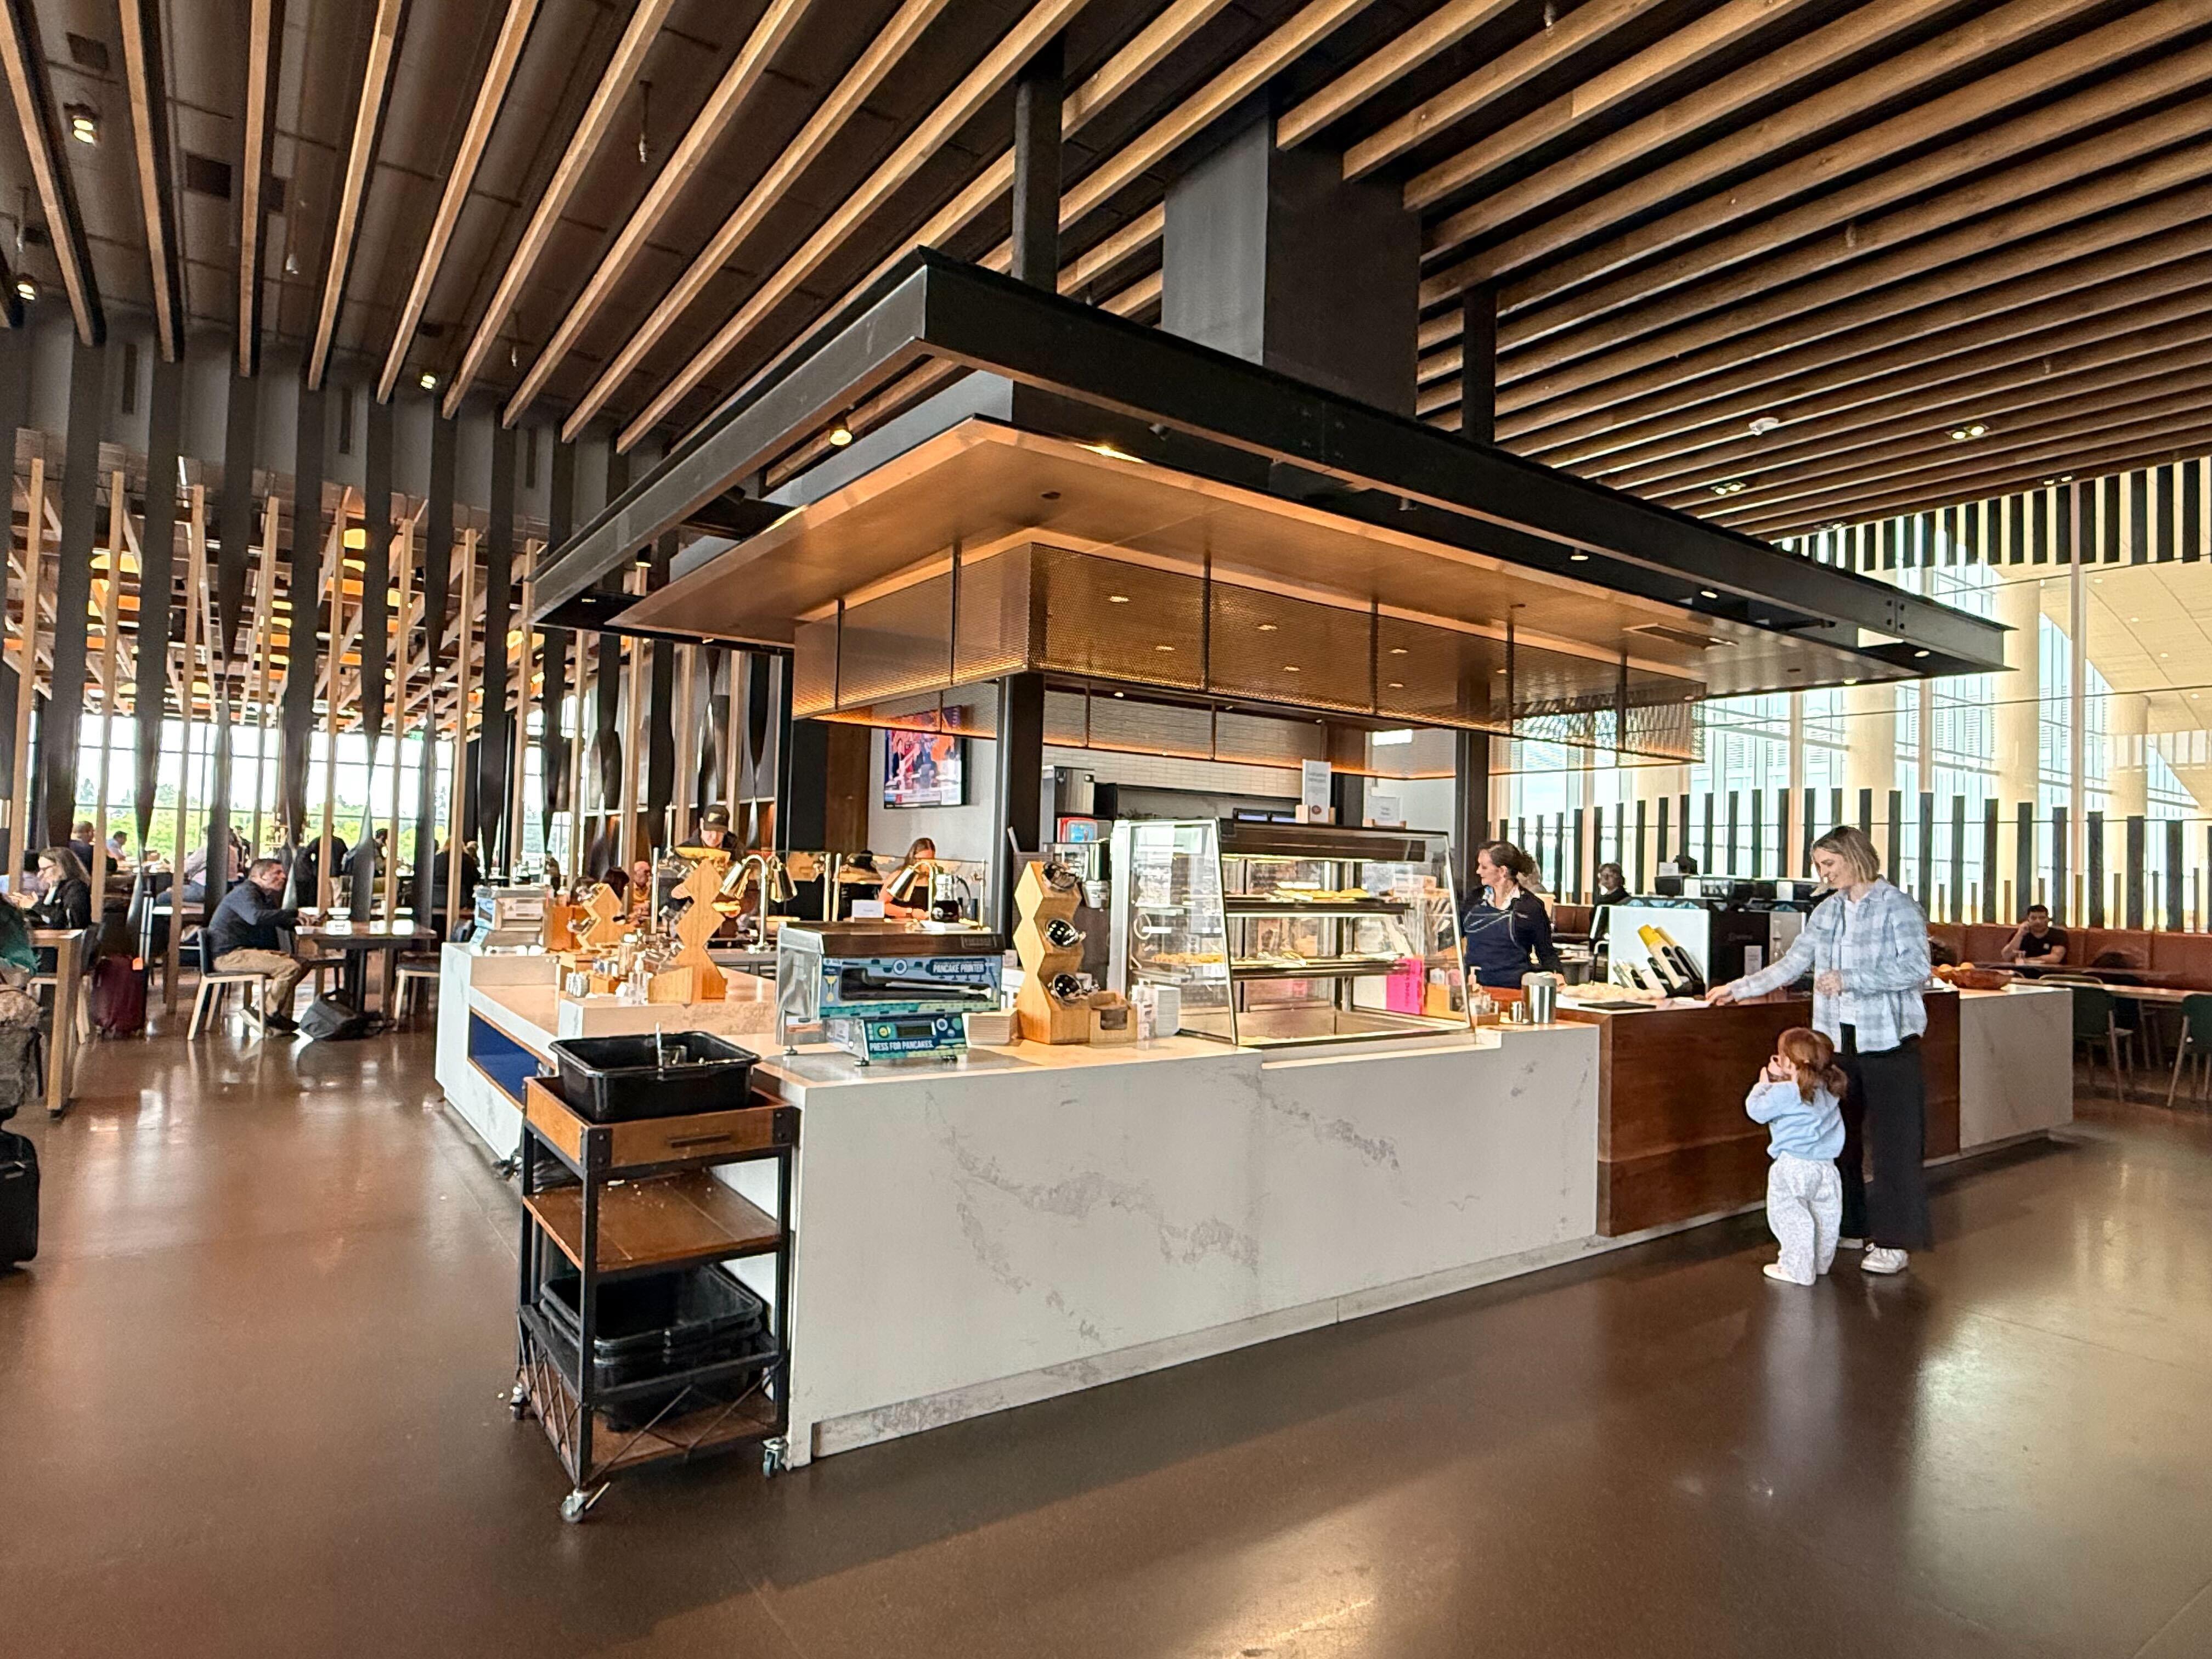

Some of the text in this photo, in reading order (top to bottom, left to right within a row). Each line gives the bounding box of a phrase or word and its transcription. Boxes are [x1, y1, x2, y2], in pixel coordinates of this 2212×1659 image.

[933, 963, 984, 973] PANCAKE PRINTER
[869, 1042, 889, 1051] PRESS
[889, 1042, 902, 1050] FOR
